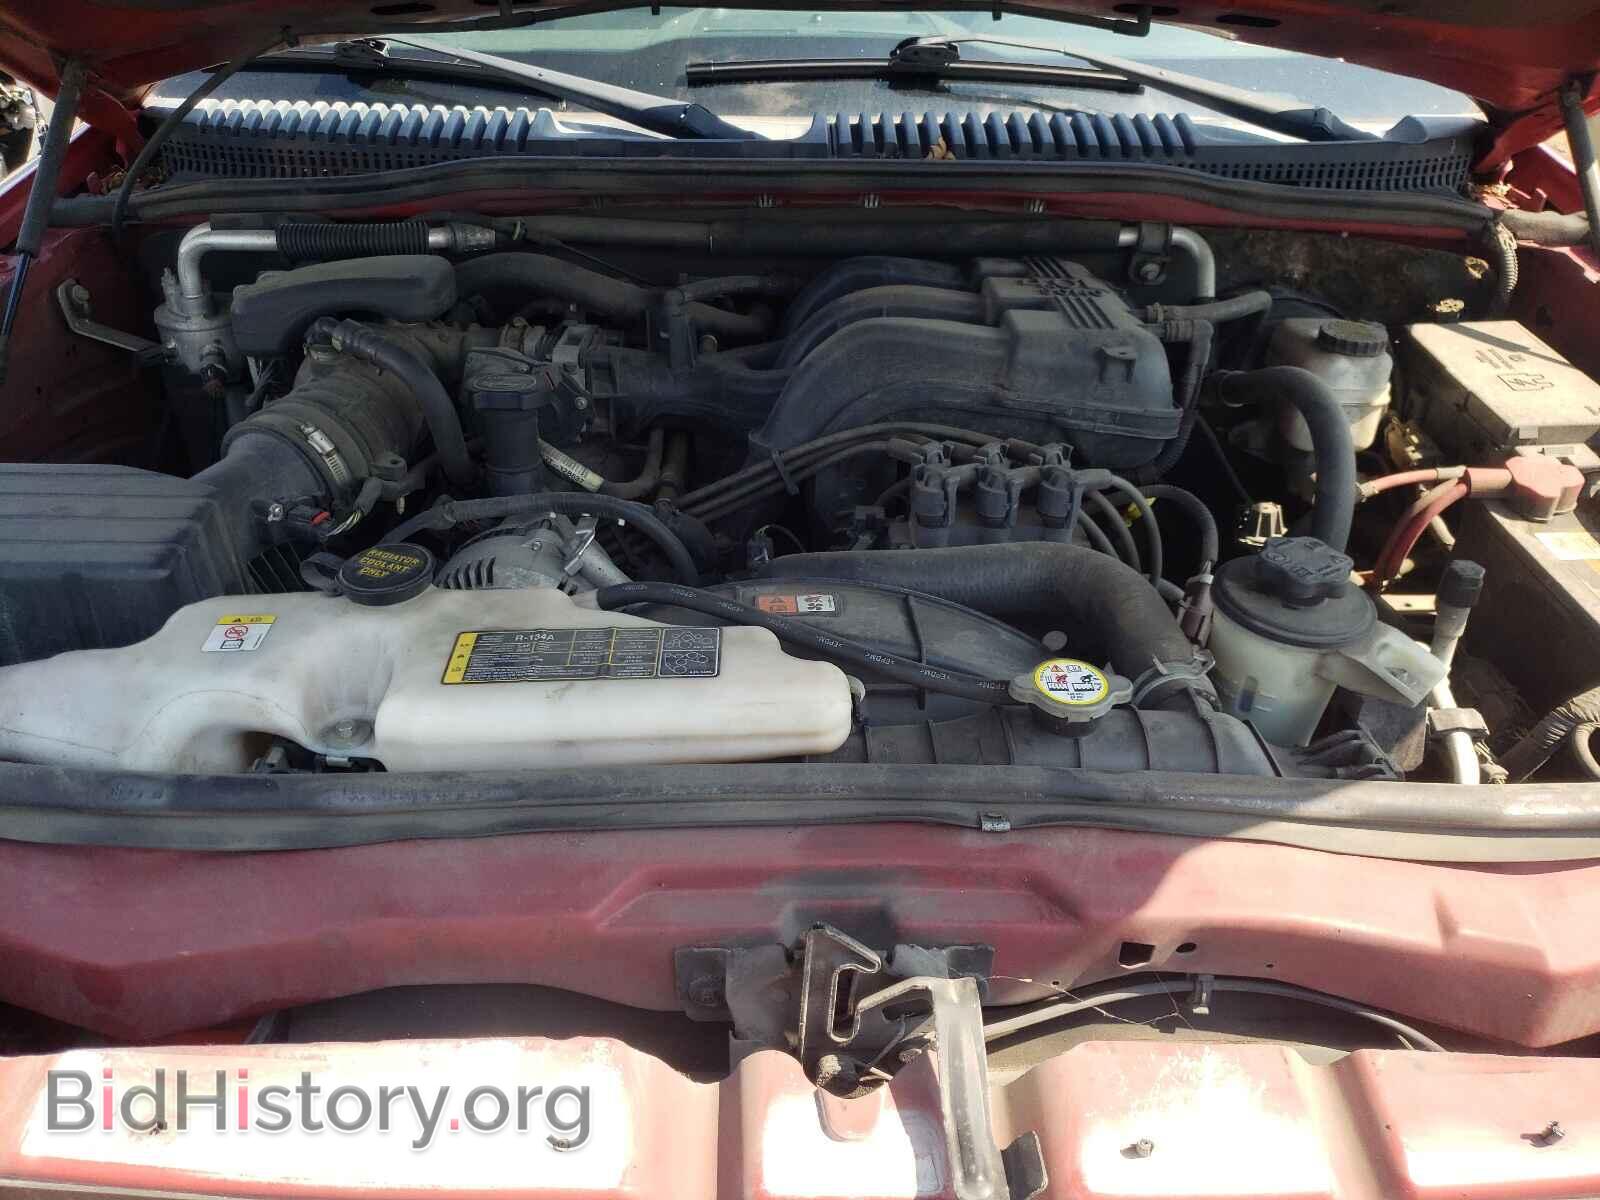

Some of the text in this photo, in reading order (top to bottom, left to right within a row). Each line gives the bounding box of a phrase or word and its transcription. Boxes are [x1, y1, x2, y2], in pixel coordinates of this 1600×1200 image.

[359, 556, 409, 573] COOLANT
[360, 567, 389, 578] ONLY
[515, 633, 555, 642] R-134A
